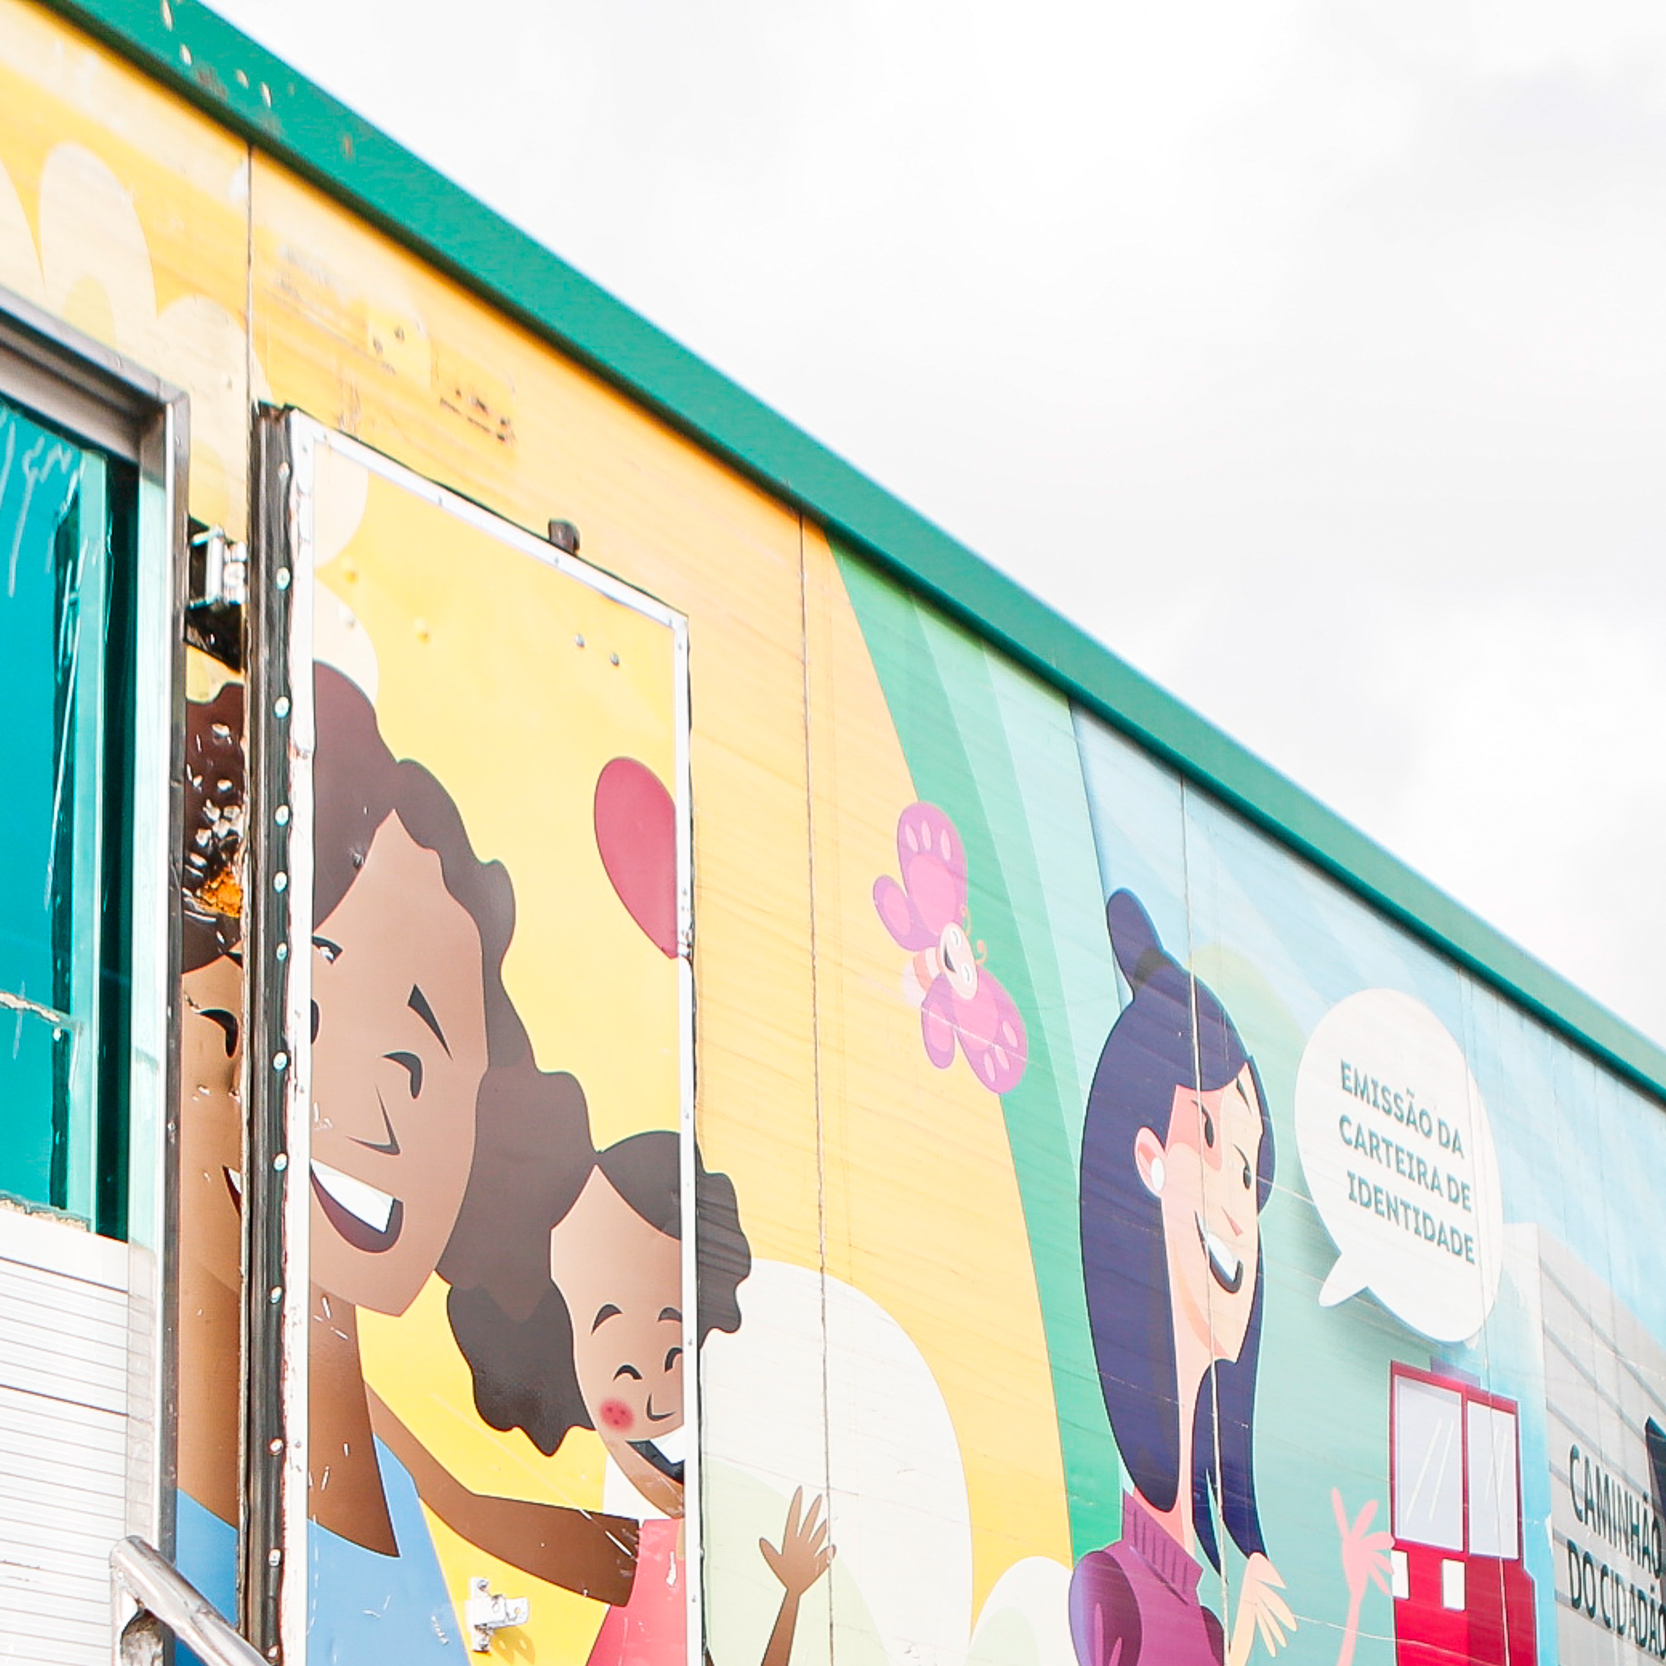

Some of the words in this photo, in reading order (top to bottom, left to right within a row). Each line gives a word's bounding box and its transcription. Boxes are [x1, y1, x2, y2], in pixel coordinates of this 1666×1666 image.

[1340, 1059, 1433, 1139] EMISSÃO
[1438, 1117, 1465, 1159] DA
[1339, 1114, 1444, 1198] CARTEIRA
[1447, 1173, 1472, 1213] DE
[1347, 1170, 1475, 1265] IDENTIDADE
[1569, 1444, 1662, 1579] CAMINHÃO
[1567, 1539, 1595, 1620] DO
